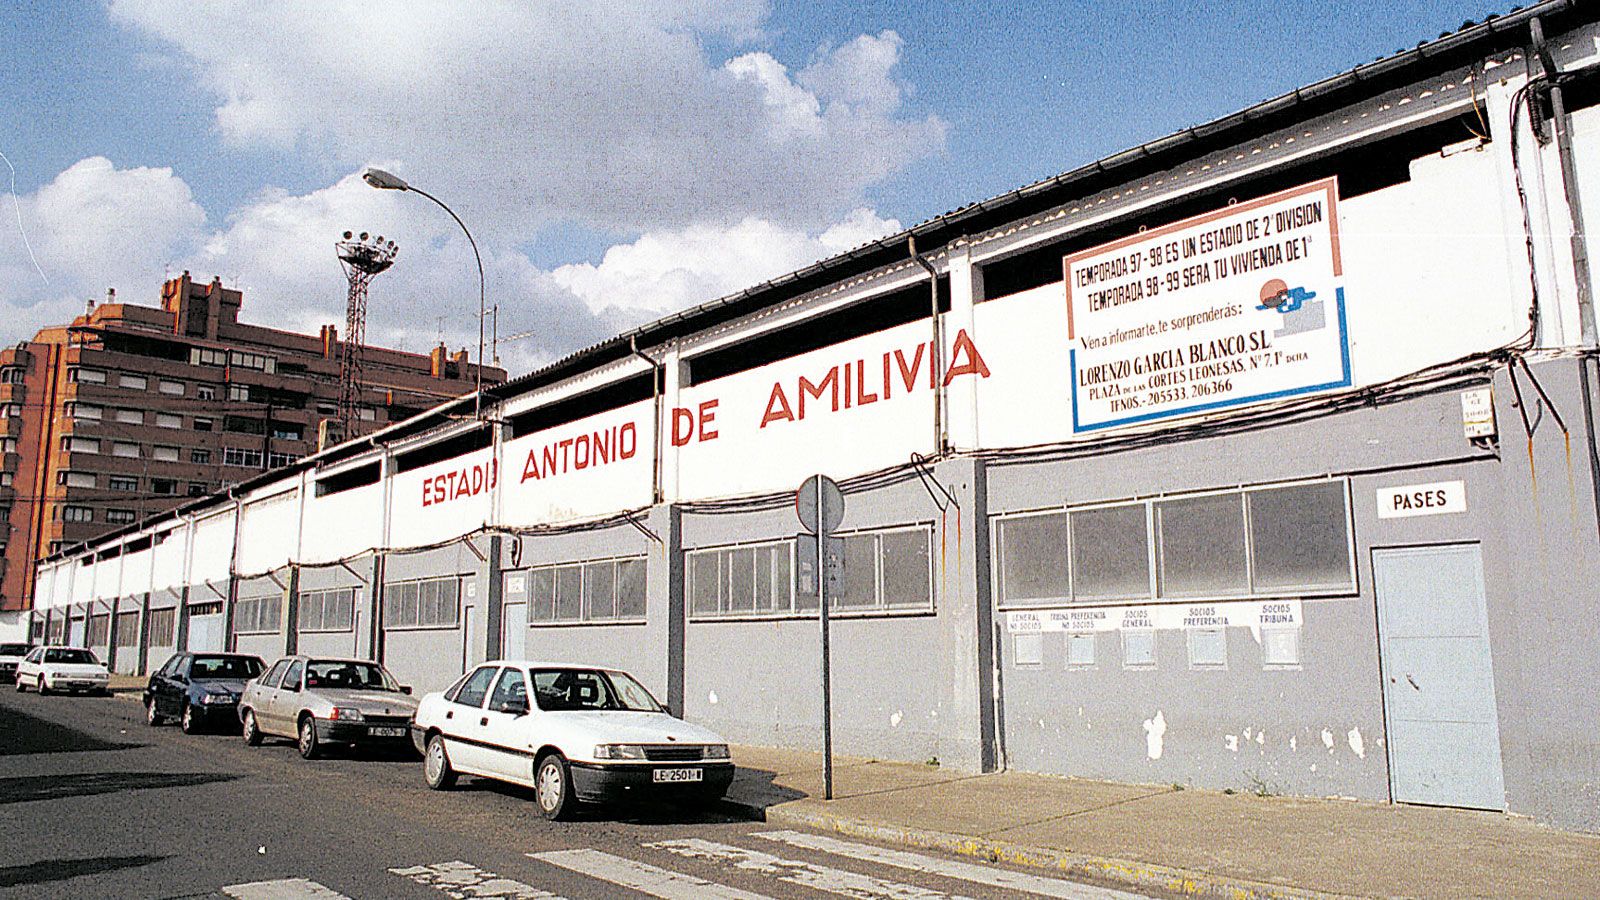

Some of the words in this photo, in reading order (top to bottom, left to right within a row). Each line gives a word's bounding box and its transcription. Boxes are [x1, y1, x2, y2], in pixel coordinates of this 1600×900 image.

[1076, 257, 1128, 288] TEMPORADA
[1166, 242, 1179, 263] ES
[1182, 237, 1197, 259] UN
[1200, 223, 1243, 254] ESTADIO
[1246, 219, 1259, 241] DE
[1276, 201, 1322, 233] DIVISION
[1088, 280, 1144, 312] TEMPORADA
[1183, 262, 1211, 288] SERA
[1214, 258, 1227, 280] TU
[1231, 243, 1283, 275] VIVIENDA
[1286, 238, 1300, 262] DE
[1081, 336, 1101, 350] Ven
[1102, 336, 1108, 347] a
[1080, 359, 1131, 387] LORENZO
[1134, 348, 1185, 375] GARCIA
[1089, 383, 1121, 401] PLAZA
[1134, 383, 1146, 392] LAS
[1148, 369, 1187, 389] CORTES
[1191, 378, 1233, 398] 206366
[520, 421, 637, 484] ANTONIO
[671, 398, 719, 448] DE
[760, 328, 991, 429] AMILIVIA
[1393, 489, 1447, 511] PASES
[1124, 610, 1148, 619] SOCIOS
[1189, 607, 1216, 616] SOCIOS
[1262, 604, 1291, 613] SOCIOS
[1072, 621, 1095, 629] SOCIOS
[1122, 619, 1153, 628] GENERAL
[1183, 616, 1229, 626] PREFERENCIA
[1259, 614, 1294, 624] TRIBUNA
